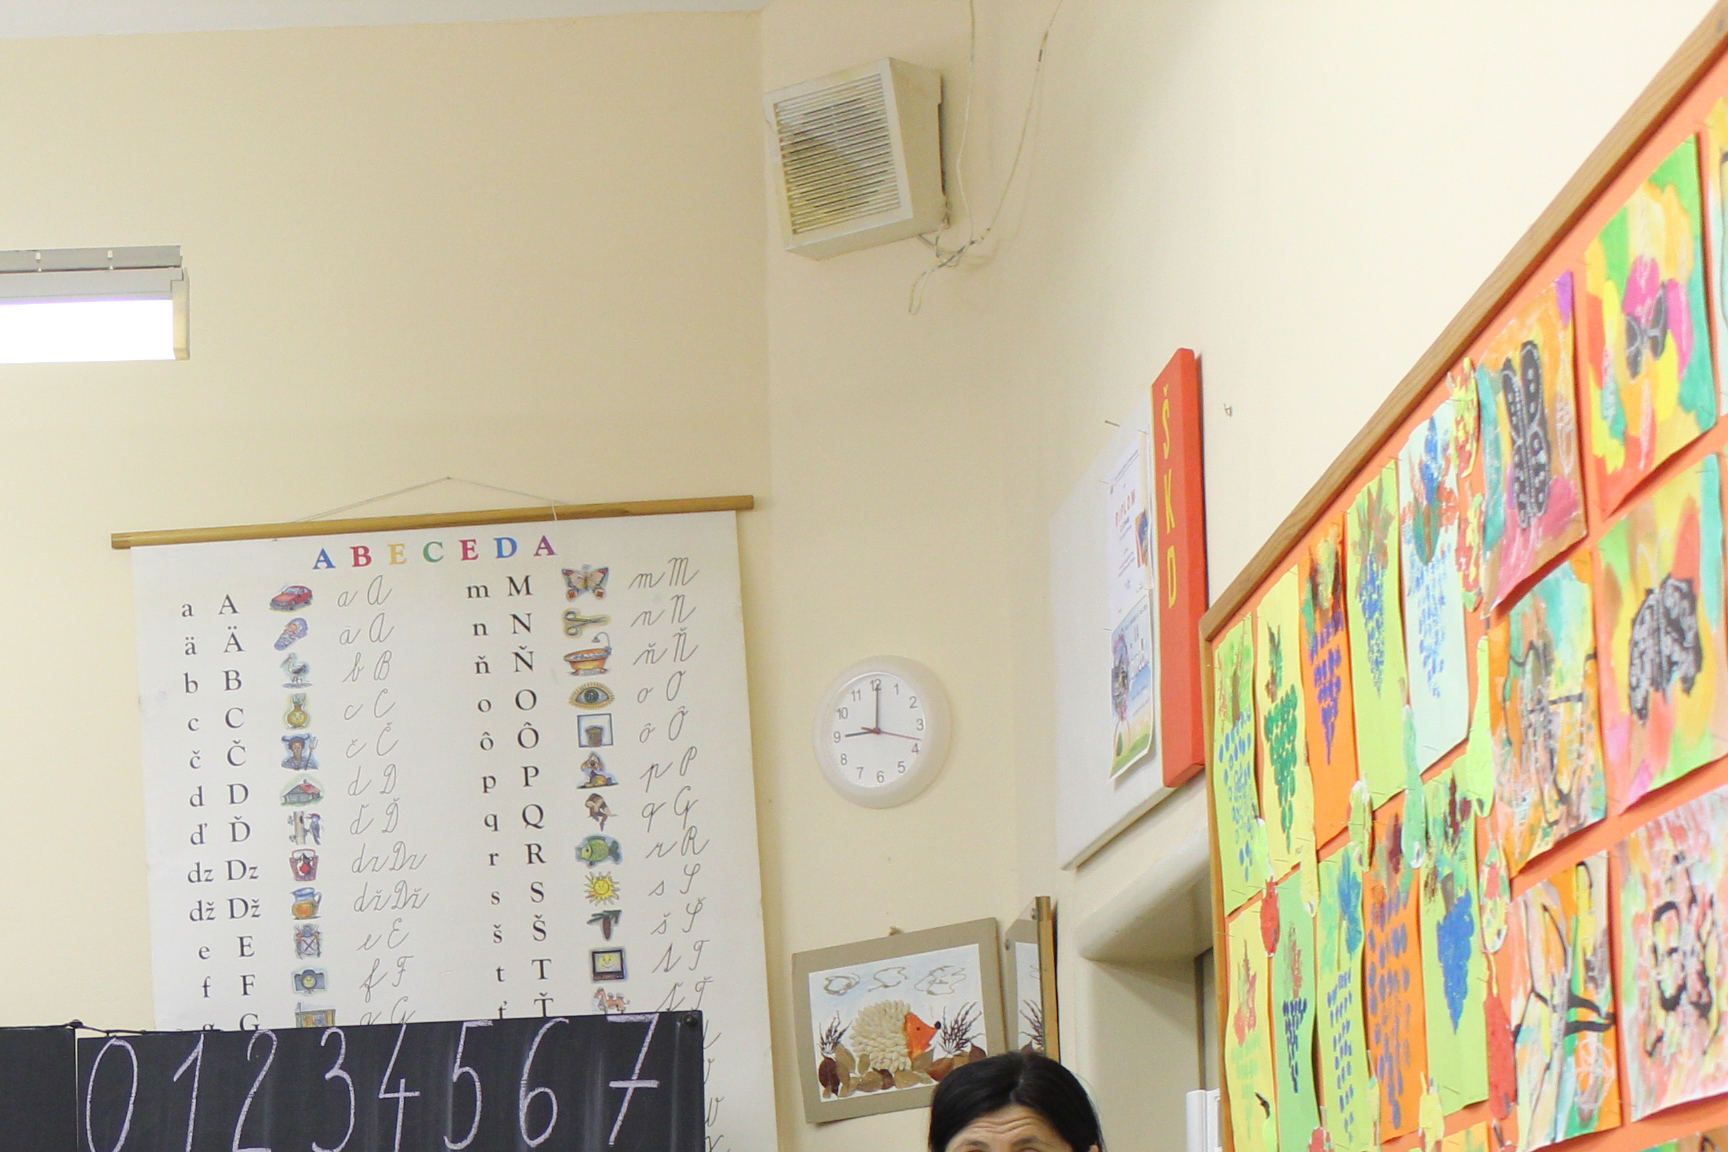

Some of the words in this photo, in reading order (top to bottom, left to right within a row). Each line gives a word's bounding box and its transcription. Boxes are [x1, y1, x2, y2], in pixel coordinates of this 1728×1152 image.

[312, 534, 557, 570] ABECEDA
[870, 678, 882, 693] 12
[893, 683, 900, 696] 1
[850, 689, 862, 702] 11
[909, 695, 918, 709] 2
[836, 706, 849, 720] 10
[916, 718, 924, 732] 3
[833, 730, 842, 744] 9
[911, 742, 920, 754] 4
[840, 753, 848, 766] 8
[856, 766, 864, 780] 7
[897, 760, 906, 774] 5
[876, 770, 885, 784] 6
[442, 1020, 493, 1150] 5
[519, 1018, 569, 1147] 6
[604, 1013, 659, 1145] 7
